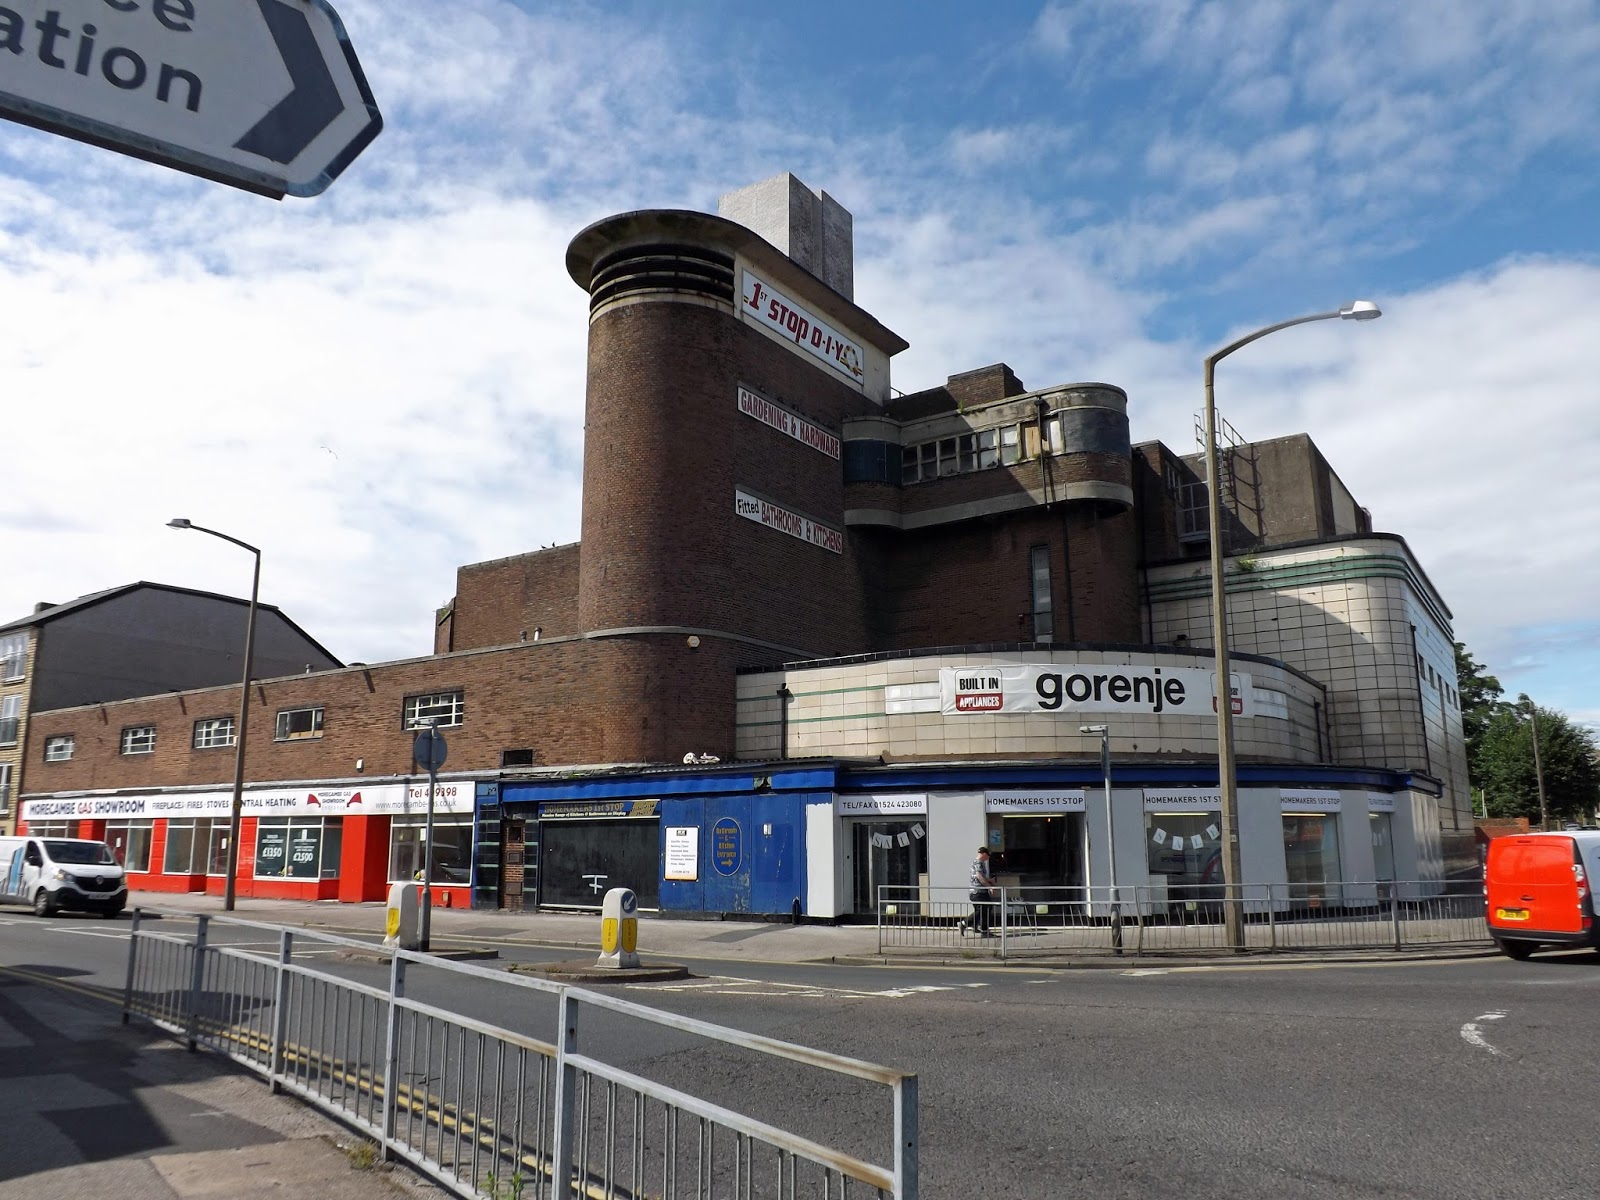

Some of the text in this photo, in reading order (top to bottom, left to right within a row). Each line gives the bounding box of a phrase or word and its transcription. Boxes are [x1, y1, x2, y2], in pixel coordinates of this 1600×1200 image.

[741, 390, 839, 459] GARDENING & HARDWARE
[737, 498, 842, 553] Fitted BATHROOMS & KITCHENS
[960, 677, 999, 690] BUILT IN
[1036, 668, 1186, 712] gorenje
[959, 696, 1000, 708] APPLIANCES
[409, 788, 422, 798] Tel
[187, 801, 203, 809] FIRES
[207, 800, 229, 808] STOVES
[240, 799, 263, 808] NTRAL
[265, 798, 297, 806] HEATING
[842, 800, 923, 810] TEL/FAX 01524 423080
[987, 797, 1084, 806] HOMEMAKERS 1ST STOP
[1145, 796, 1198, 804] HOMEMAKERS
[1280, 797, 1317, 805] HOMEMAKERS
[1317, 797, 1326, 805] 1ST
[29, 800, 145, 815] MORECAMBE GAS SHOWROOM
[605, 803, 625, 812] STOP
[262, 847, 282, 857] £1350
